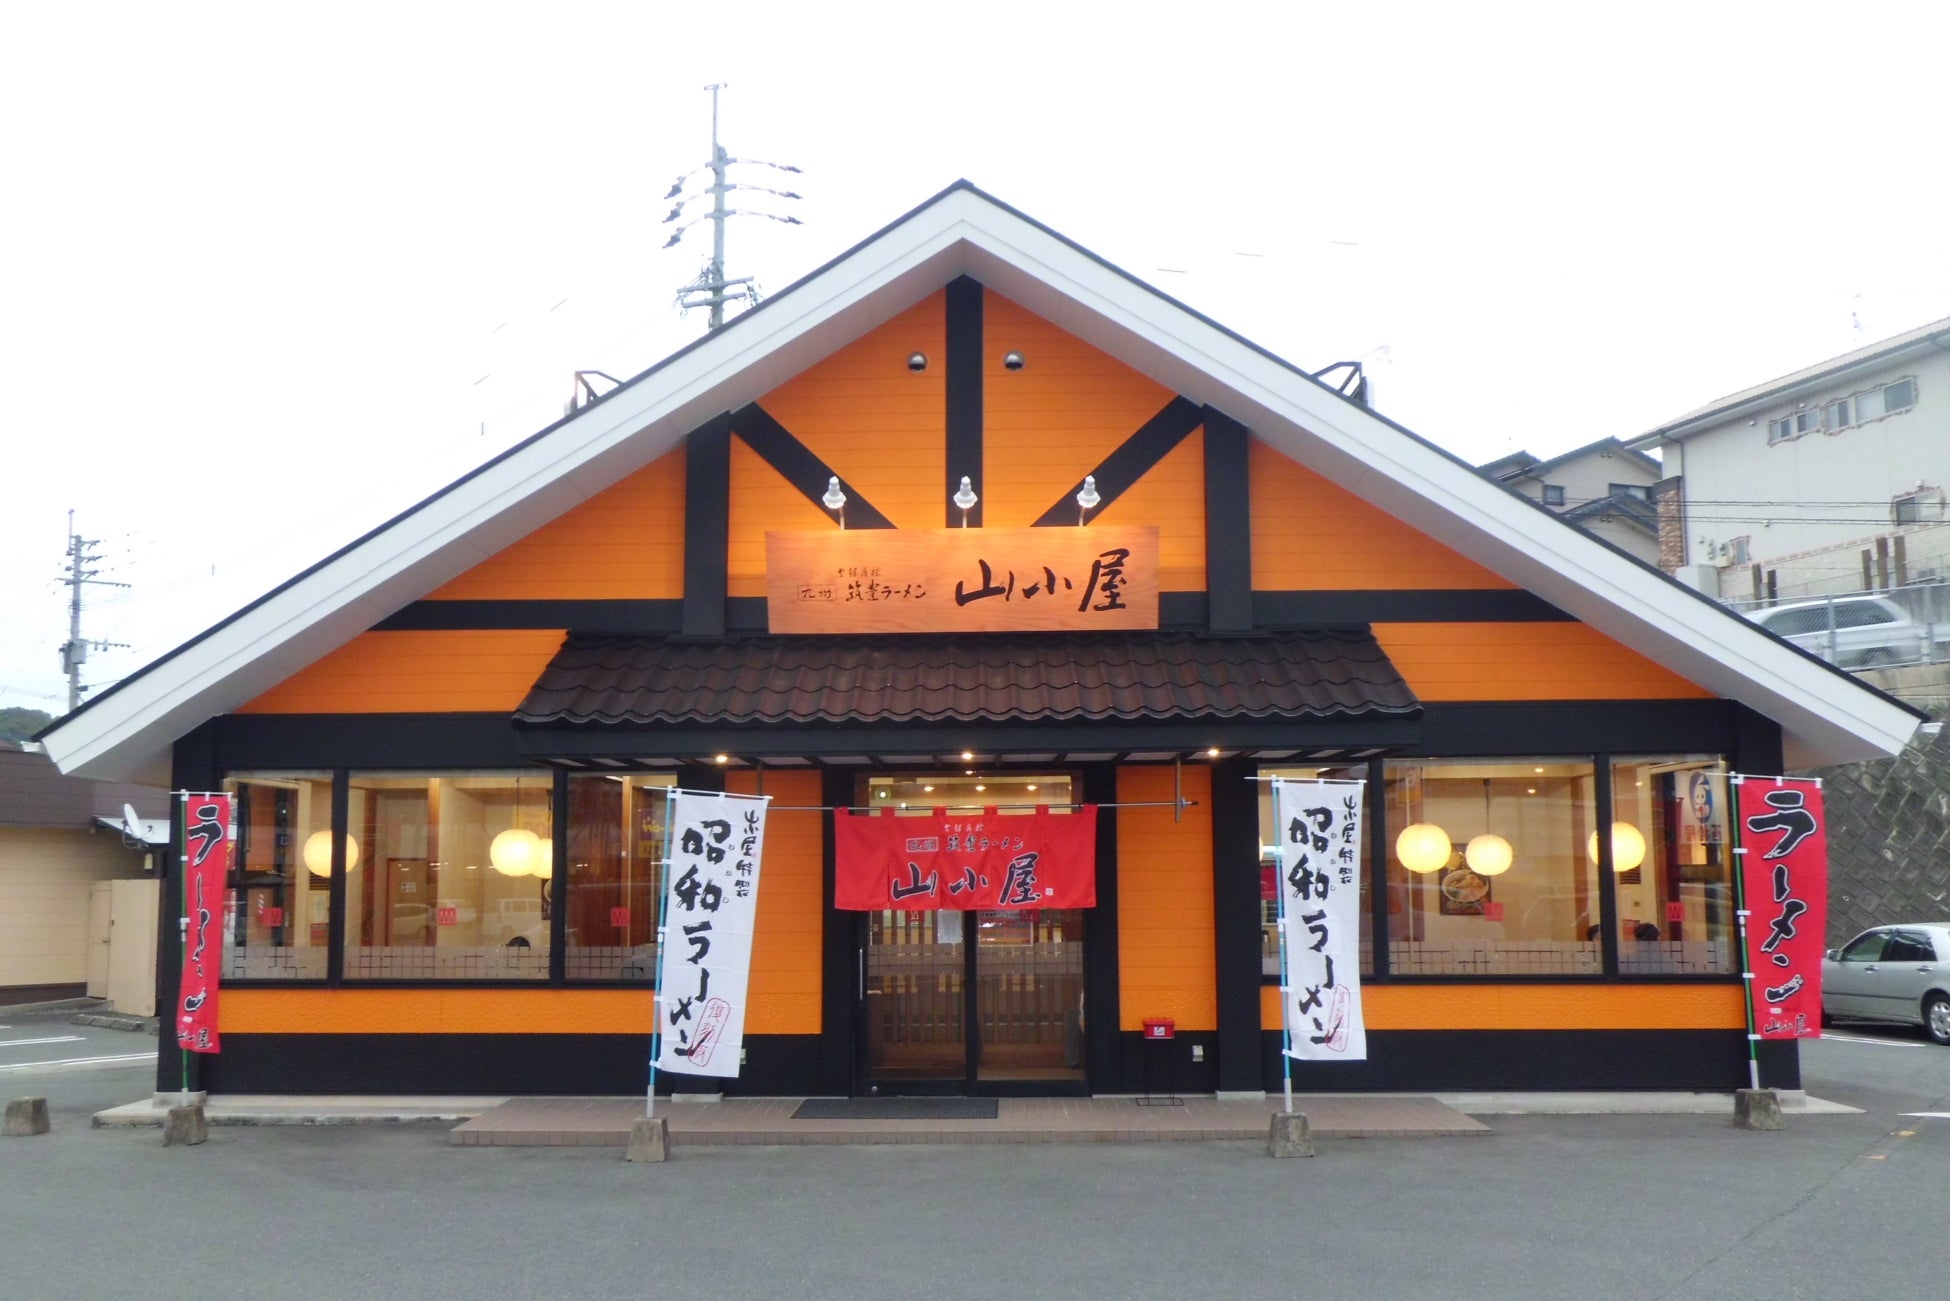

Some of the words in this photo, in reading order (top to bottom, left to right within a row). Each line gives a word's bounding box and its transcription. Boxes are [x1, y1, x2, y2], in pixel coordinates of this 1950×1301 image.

[845, 579, 926, 602] 筑豊ラーメン
[955, 548, 1130, 612] 山小屋
[892, 852, 1040, 905] 山小屋
[1747, 790, 1816, 1002] ラーメン
[670, 819, 731, 1057] 昭和ラーメン
[1288, 806, 1343, 1045] 昭和ラーメン
[1765, 1013, 1808, 1035] 山小屋
